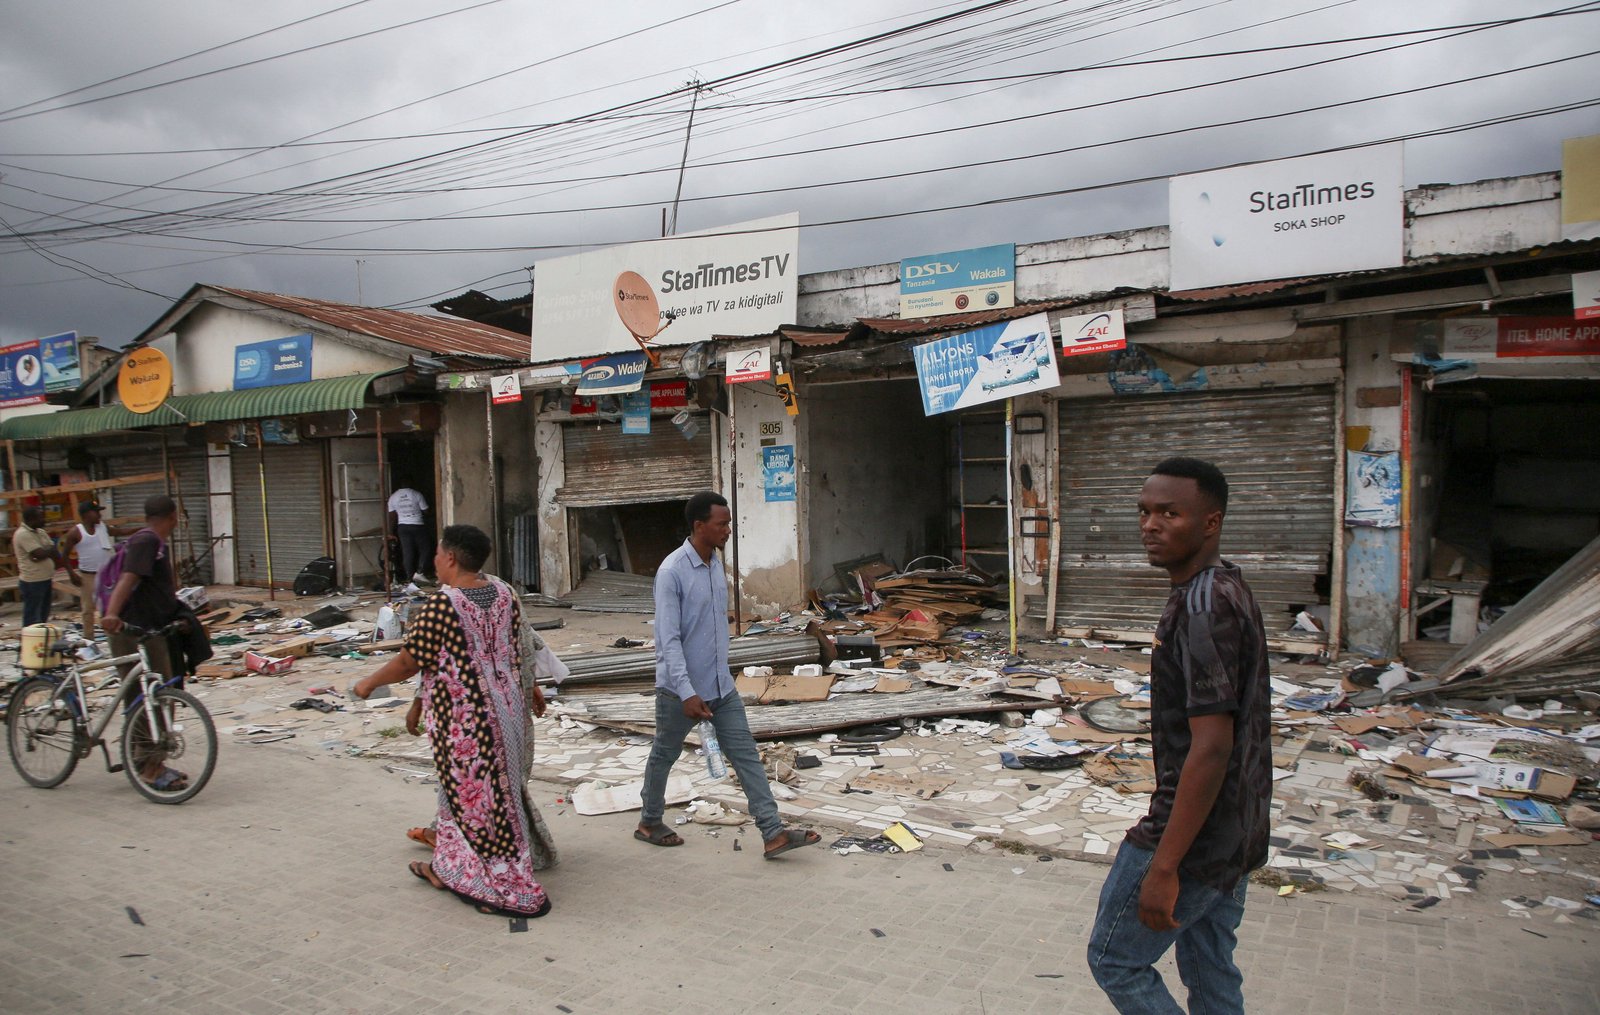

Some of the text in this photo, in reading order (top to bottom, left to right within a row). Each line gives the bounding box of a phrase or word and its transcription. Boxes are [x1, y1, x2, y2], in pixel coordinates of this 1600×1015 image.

[1249, 181, 1375, 213] StarTimes
[1274, 215, 1346, 232] SOKA SHOP
[660, 253, 790, 294] StarTimesTV
[905, 262, 960, 279] DStv
[969, 267, 1006, 281] Wakala
[906, 279, 936, 288] Tanzania
[625, 293, 649, 301] StarTimes
[689, 304, 703, 315] wa
[706, 300, 720, 313] TV
[724, 301, 735, 311] za
[738, 291, 784, 310] kidigitali
[1507, 326, 1600, 343] ITEL HOME APP
[949, 366, 975, 378] UBORA
[129, 373, 160, 385] Wakala
[661, 388, 686, 397] APPLIANCE
[761, 423, 781, 434] 305
[769, 454, 791, 463] RANGI
[766, 461, 789, 469] UBORA
